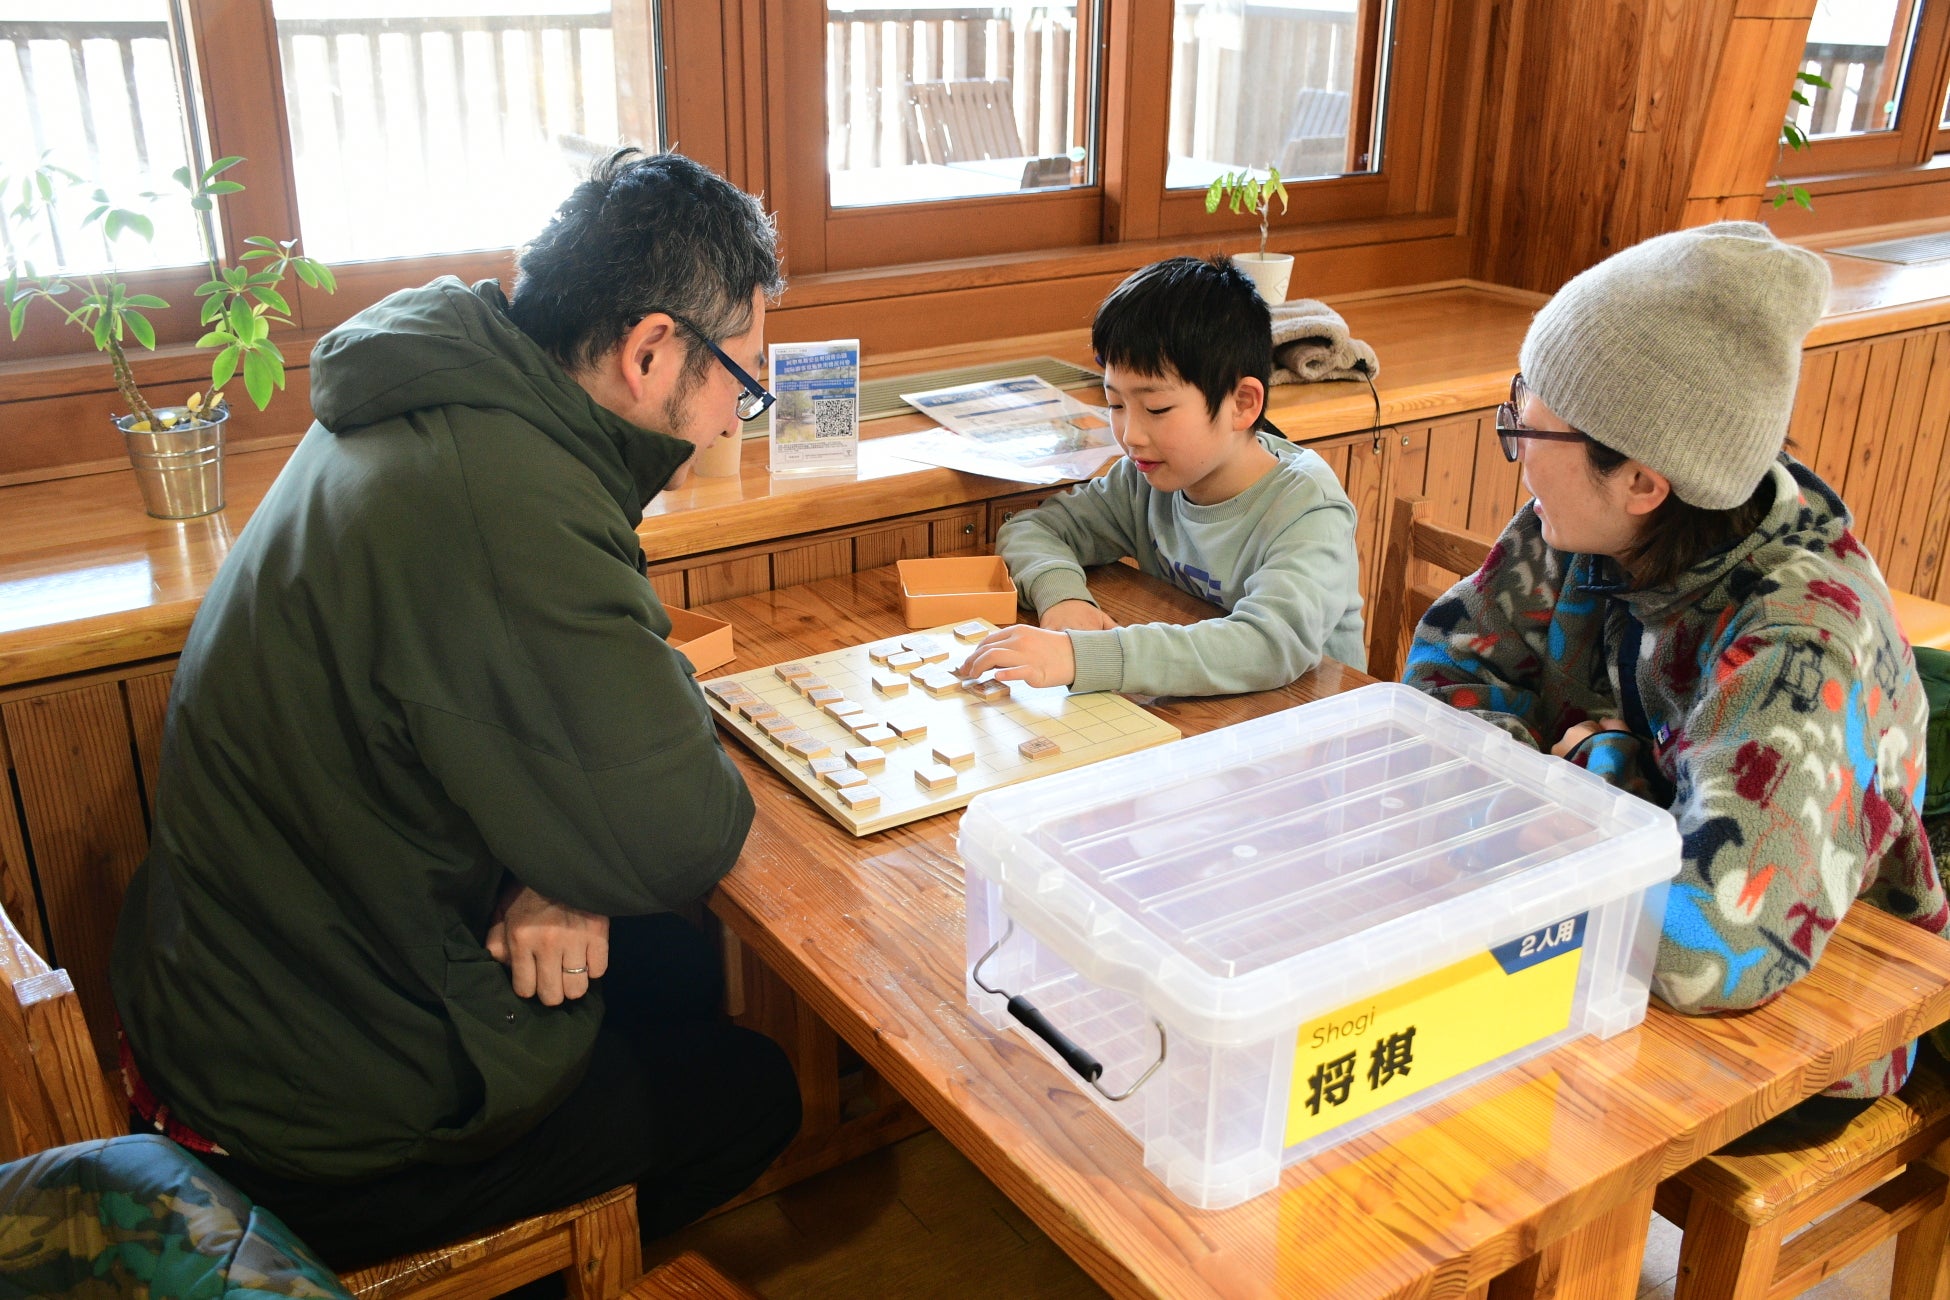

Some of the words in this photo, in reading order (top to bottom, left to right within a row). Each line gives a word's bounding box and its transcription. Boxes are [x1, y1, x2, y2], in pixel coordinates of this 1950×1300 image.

[1519, 918, 1576, 958] 2人用
[1311, 1006, 1377, 1049] Shogi
[1304, 1025, 1417, 1116] 将棋
